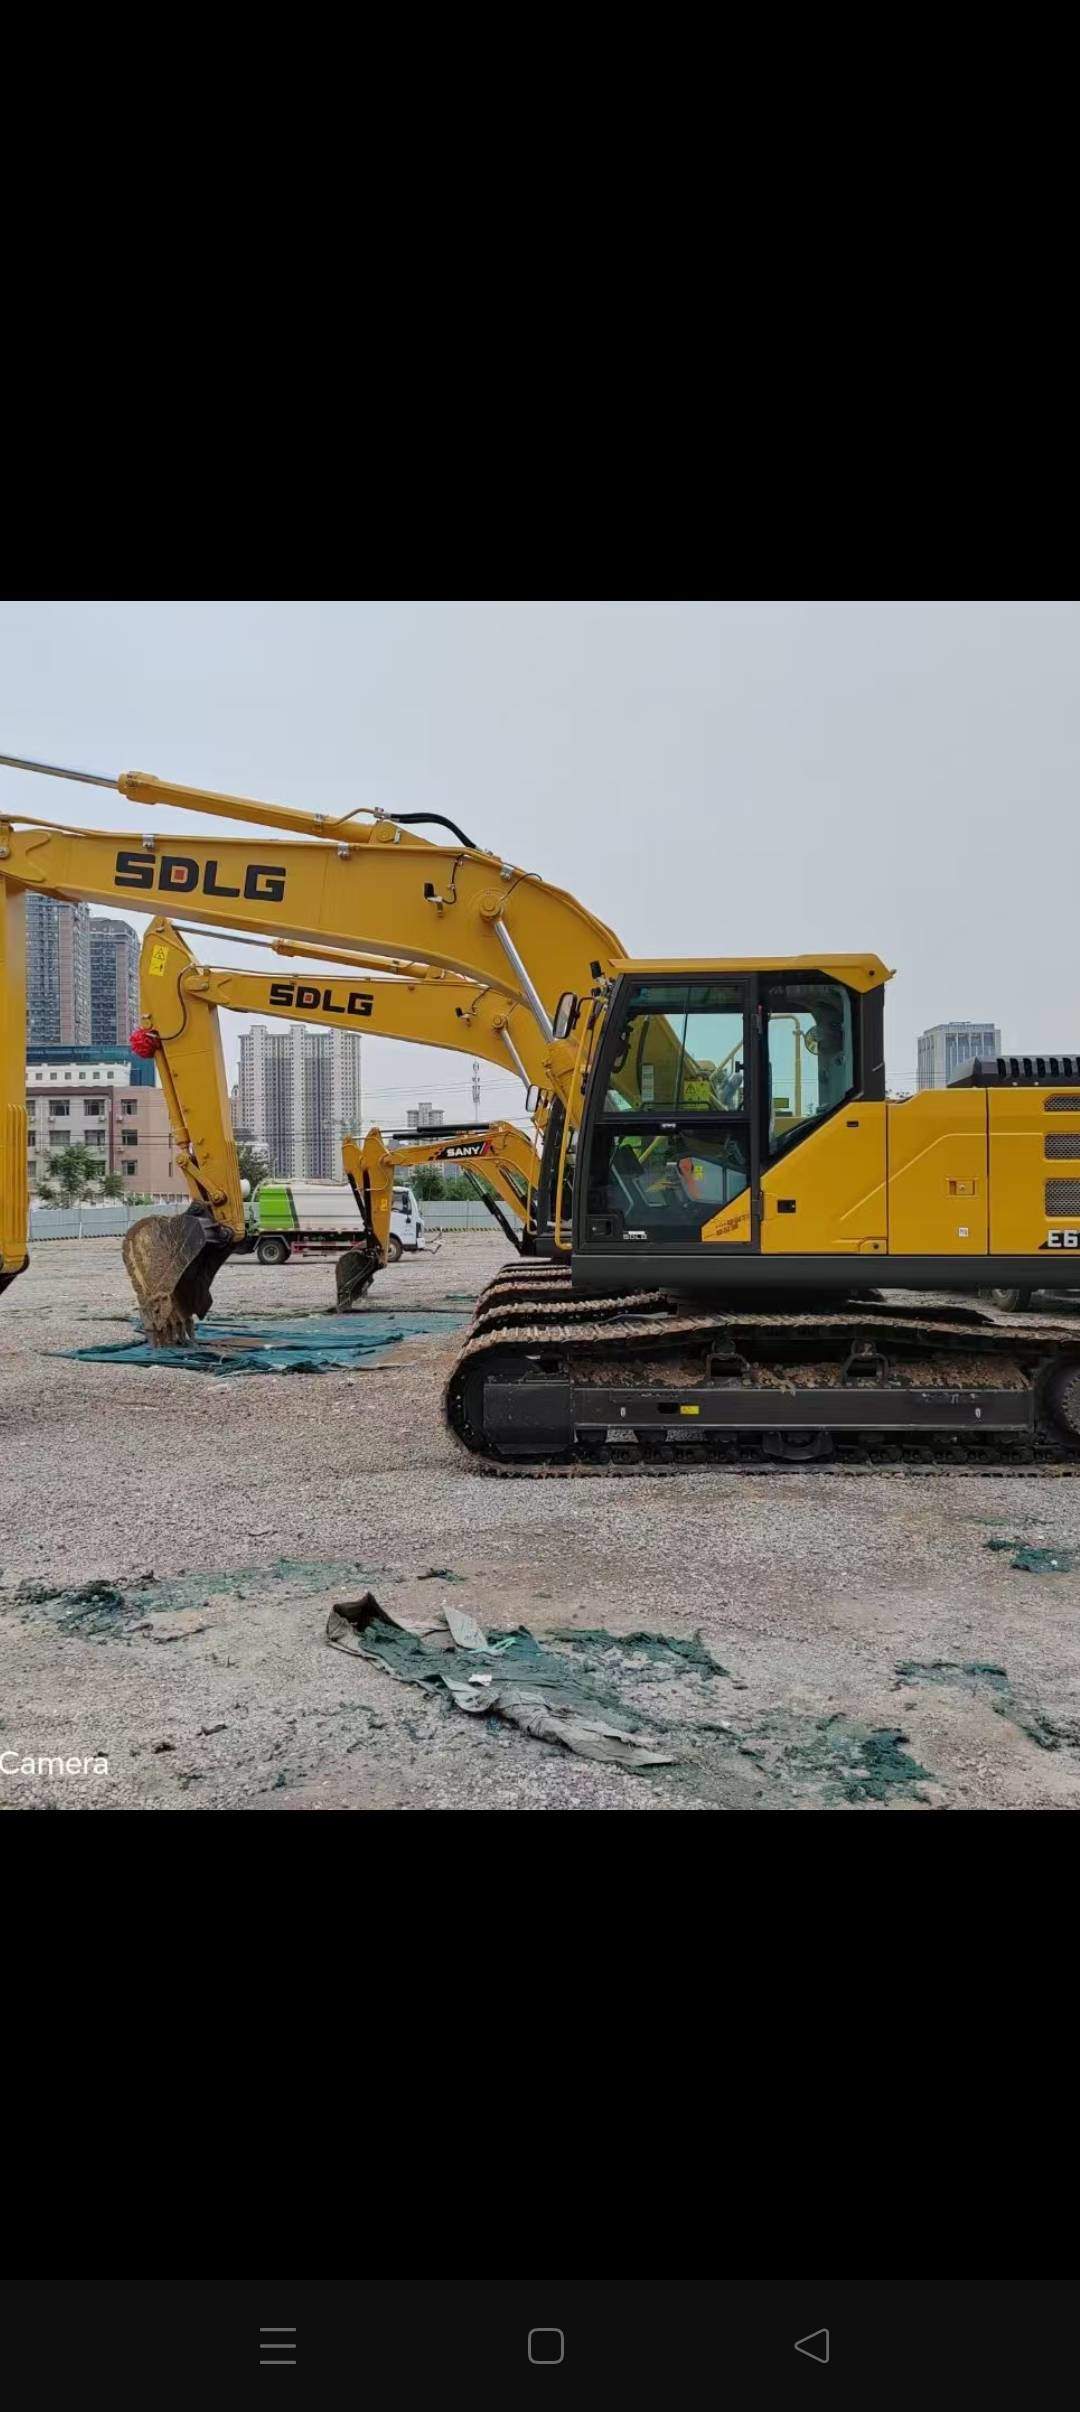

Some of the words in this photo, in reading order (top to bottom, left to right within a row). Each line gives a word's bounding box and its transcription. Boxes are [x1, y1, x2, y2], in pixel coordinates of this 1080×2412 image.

[114, 851, 286, 902] SDLG
[269, 982, 374, 1017] SDLG
[446, 1146, 480, 1157] SANY
